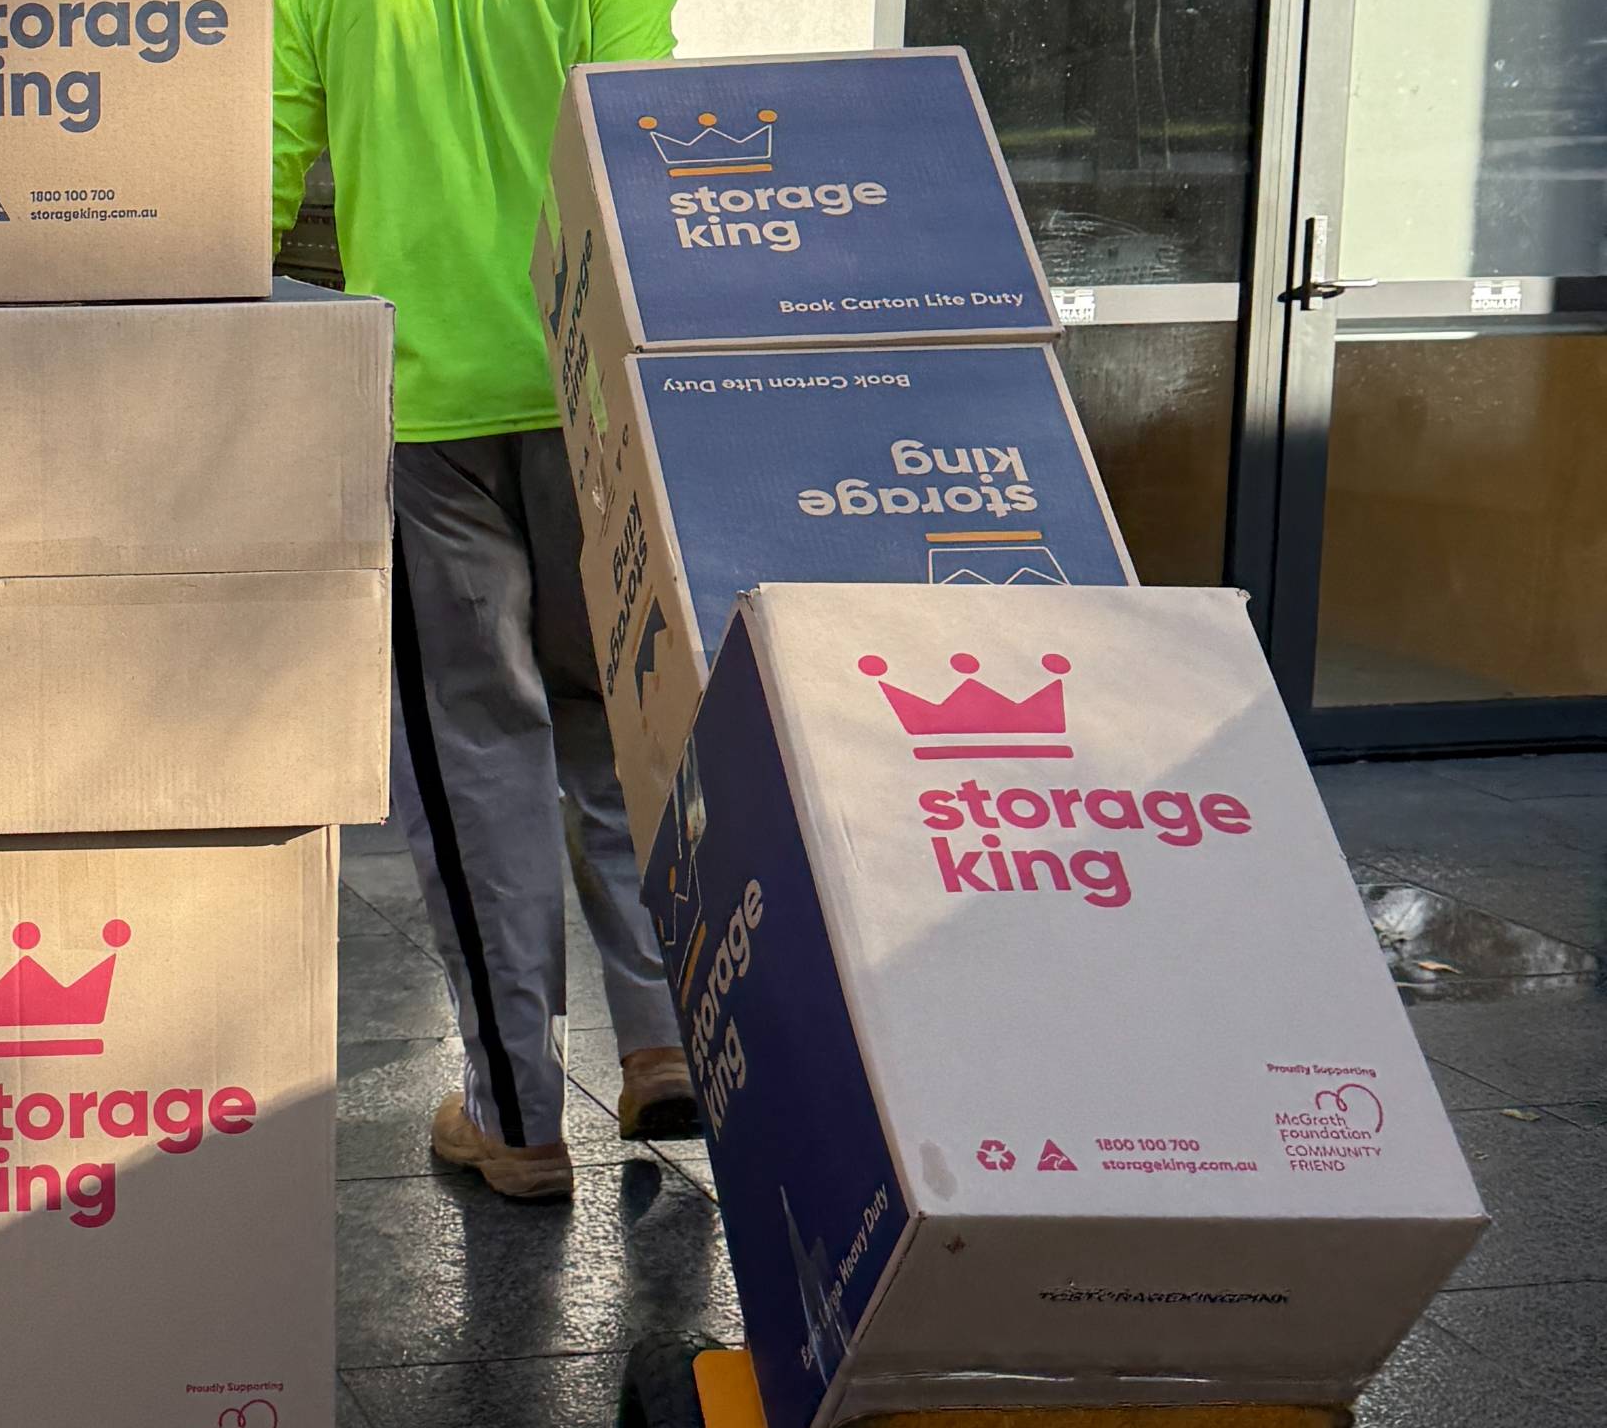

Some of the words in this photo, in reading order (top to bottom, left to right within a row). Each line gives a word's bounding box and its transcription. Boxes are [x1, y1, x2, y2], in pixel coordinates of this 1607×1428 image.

[30, 190, 61, 203] 1800
[64, 190, 87, 202] 100
[90, 189, 116, 202] 700
[669, 181, 888, 216] storage
[30, 207, 158, 223] storageking.com.au
[674, 215, 801, 252] king
[779, 298, 835, 314] Book
[841, 296, 919, 310] Carton
[924, 293, 965, 307] Lite
[971, 291, 1024, 308] Duty
[663, 376, 716, 393] Duty
[723, 376, 763, 391] Lite
[770, 374, 848, 390] Carton
[854, 373, 911, 388] Book
[890, 439, 1029, 484] king
[797, 479, 1039, 518] storage
[918, 779, 1253, 847] storage
[930, 833, 1133, 908] king
[692, 878, 764, 1083] storage
[703, 1016, 747, 1142] king
[1266, 1063, 1311, 1076] Proudly
[1312, 1064, 1377, 1079] Supporting
[1274, 1112, 1348, 1126] McGrath
[1279, 1126, 1372, 1143] Foundation
[1095, 1138, 1135, 1151] 1800
[1138, 1138, 1167, 1151] 100
[1169, 1138, 1201, 1152] 700
[1285, 1144, 1382, 1158] COMMUNITY
[1101, 1158, 1258, 1173] storageking.com.au
[1289, 1159, 1346, 1172] FRIEND
[838, 1224, 869, 1285] Heavy
[862, 1183, 889, 1234] Duty
[186, 1383, 225, 1394] Proudly
[226, 1381, 284, 1393] Supporting
